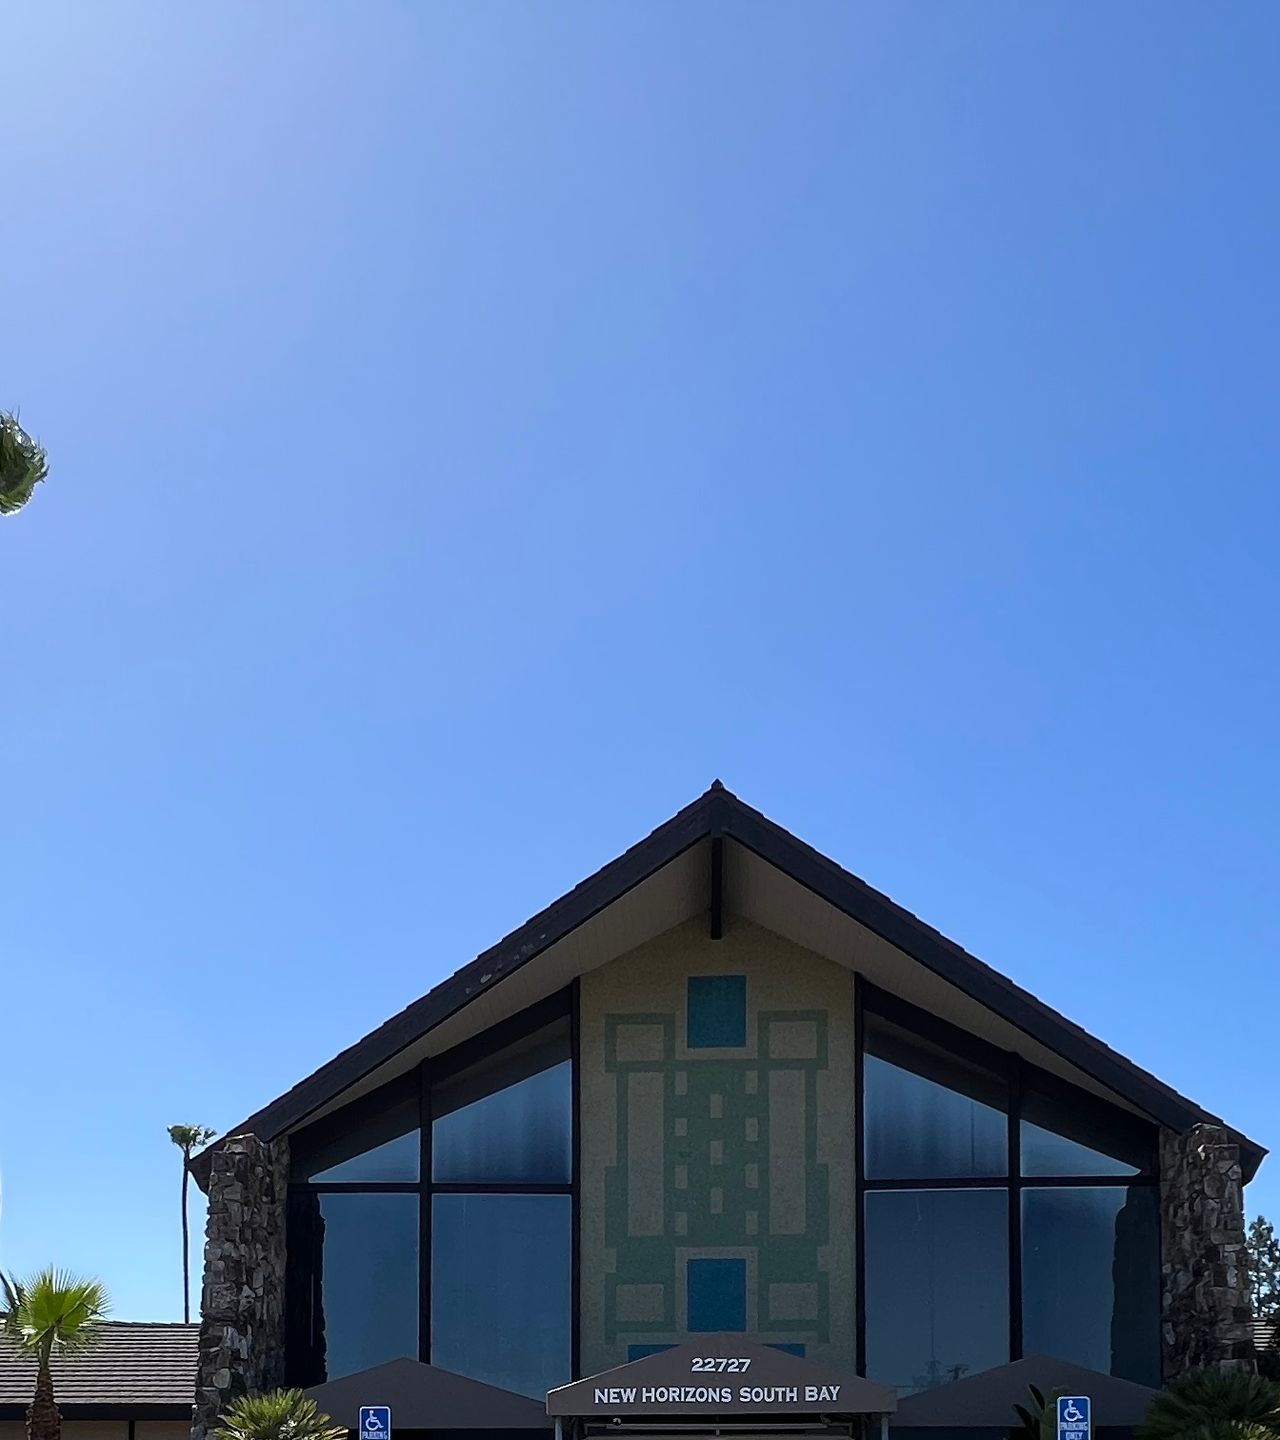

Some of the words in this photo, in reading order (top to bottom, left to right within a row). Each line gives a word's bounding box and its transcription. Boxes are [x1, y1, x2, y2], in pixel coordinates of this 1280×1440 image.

[691, 1357, 751, 1373] 22727
[594, 1388, 637, 1404] NEW
[641, 1387, 732, 1403] HORIZONS
[739, 1387, 798, 1402] SOUTH
[805, 1386, 841, 1401] BAY
